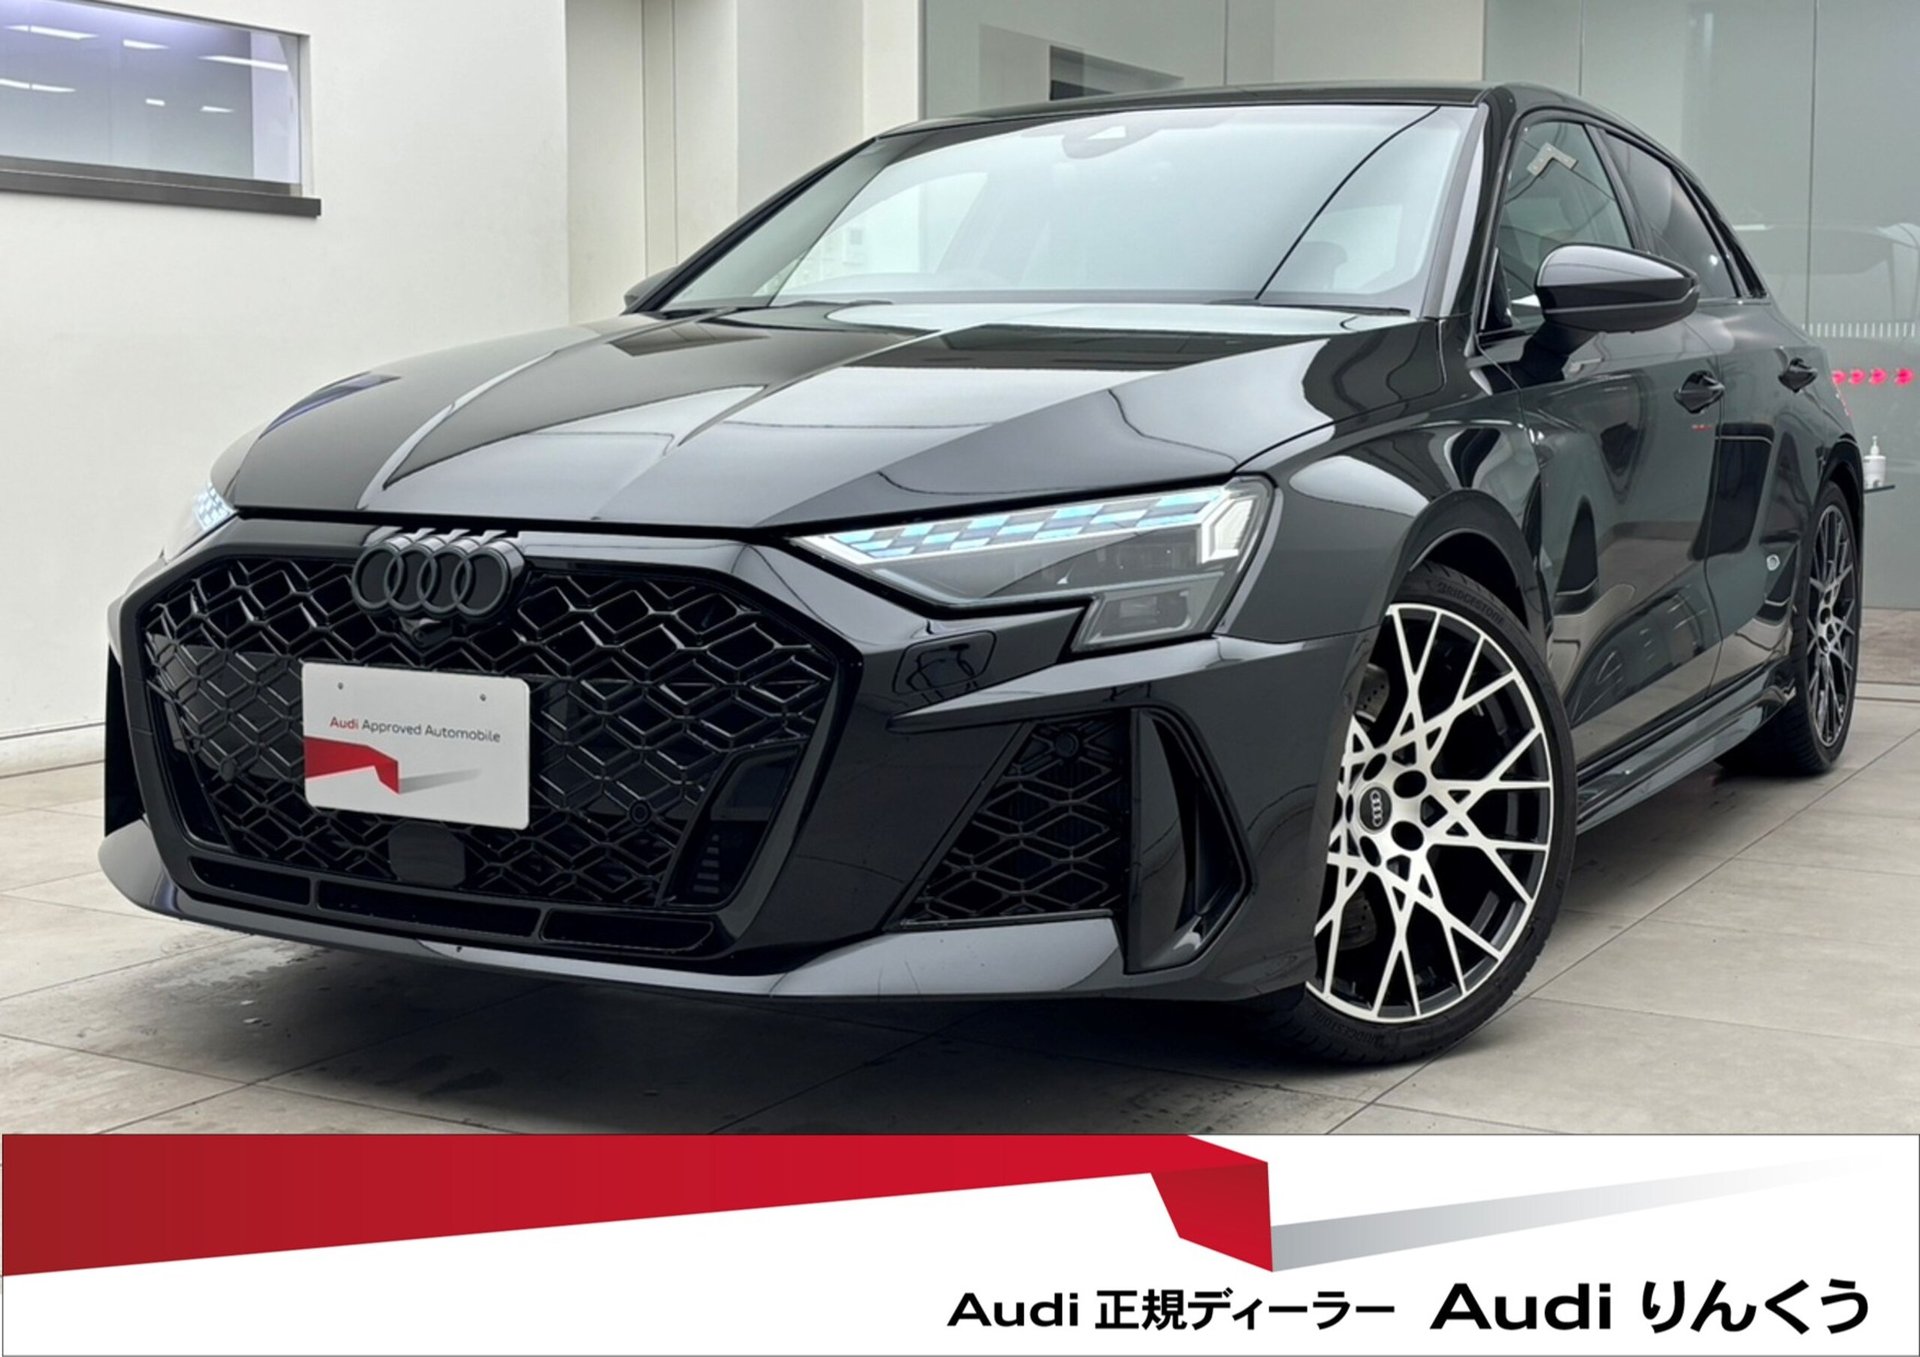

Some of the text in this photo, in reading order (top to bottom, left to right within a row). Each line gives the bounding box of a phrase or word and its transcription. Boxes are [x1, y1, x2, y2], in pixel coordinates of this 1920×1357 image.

[330, 716, 501, 743] Audi Approved Automobile
